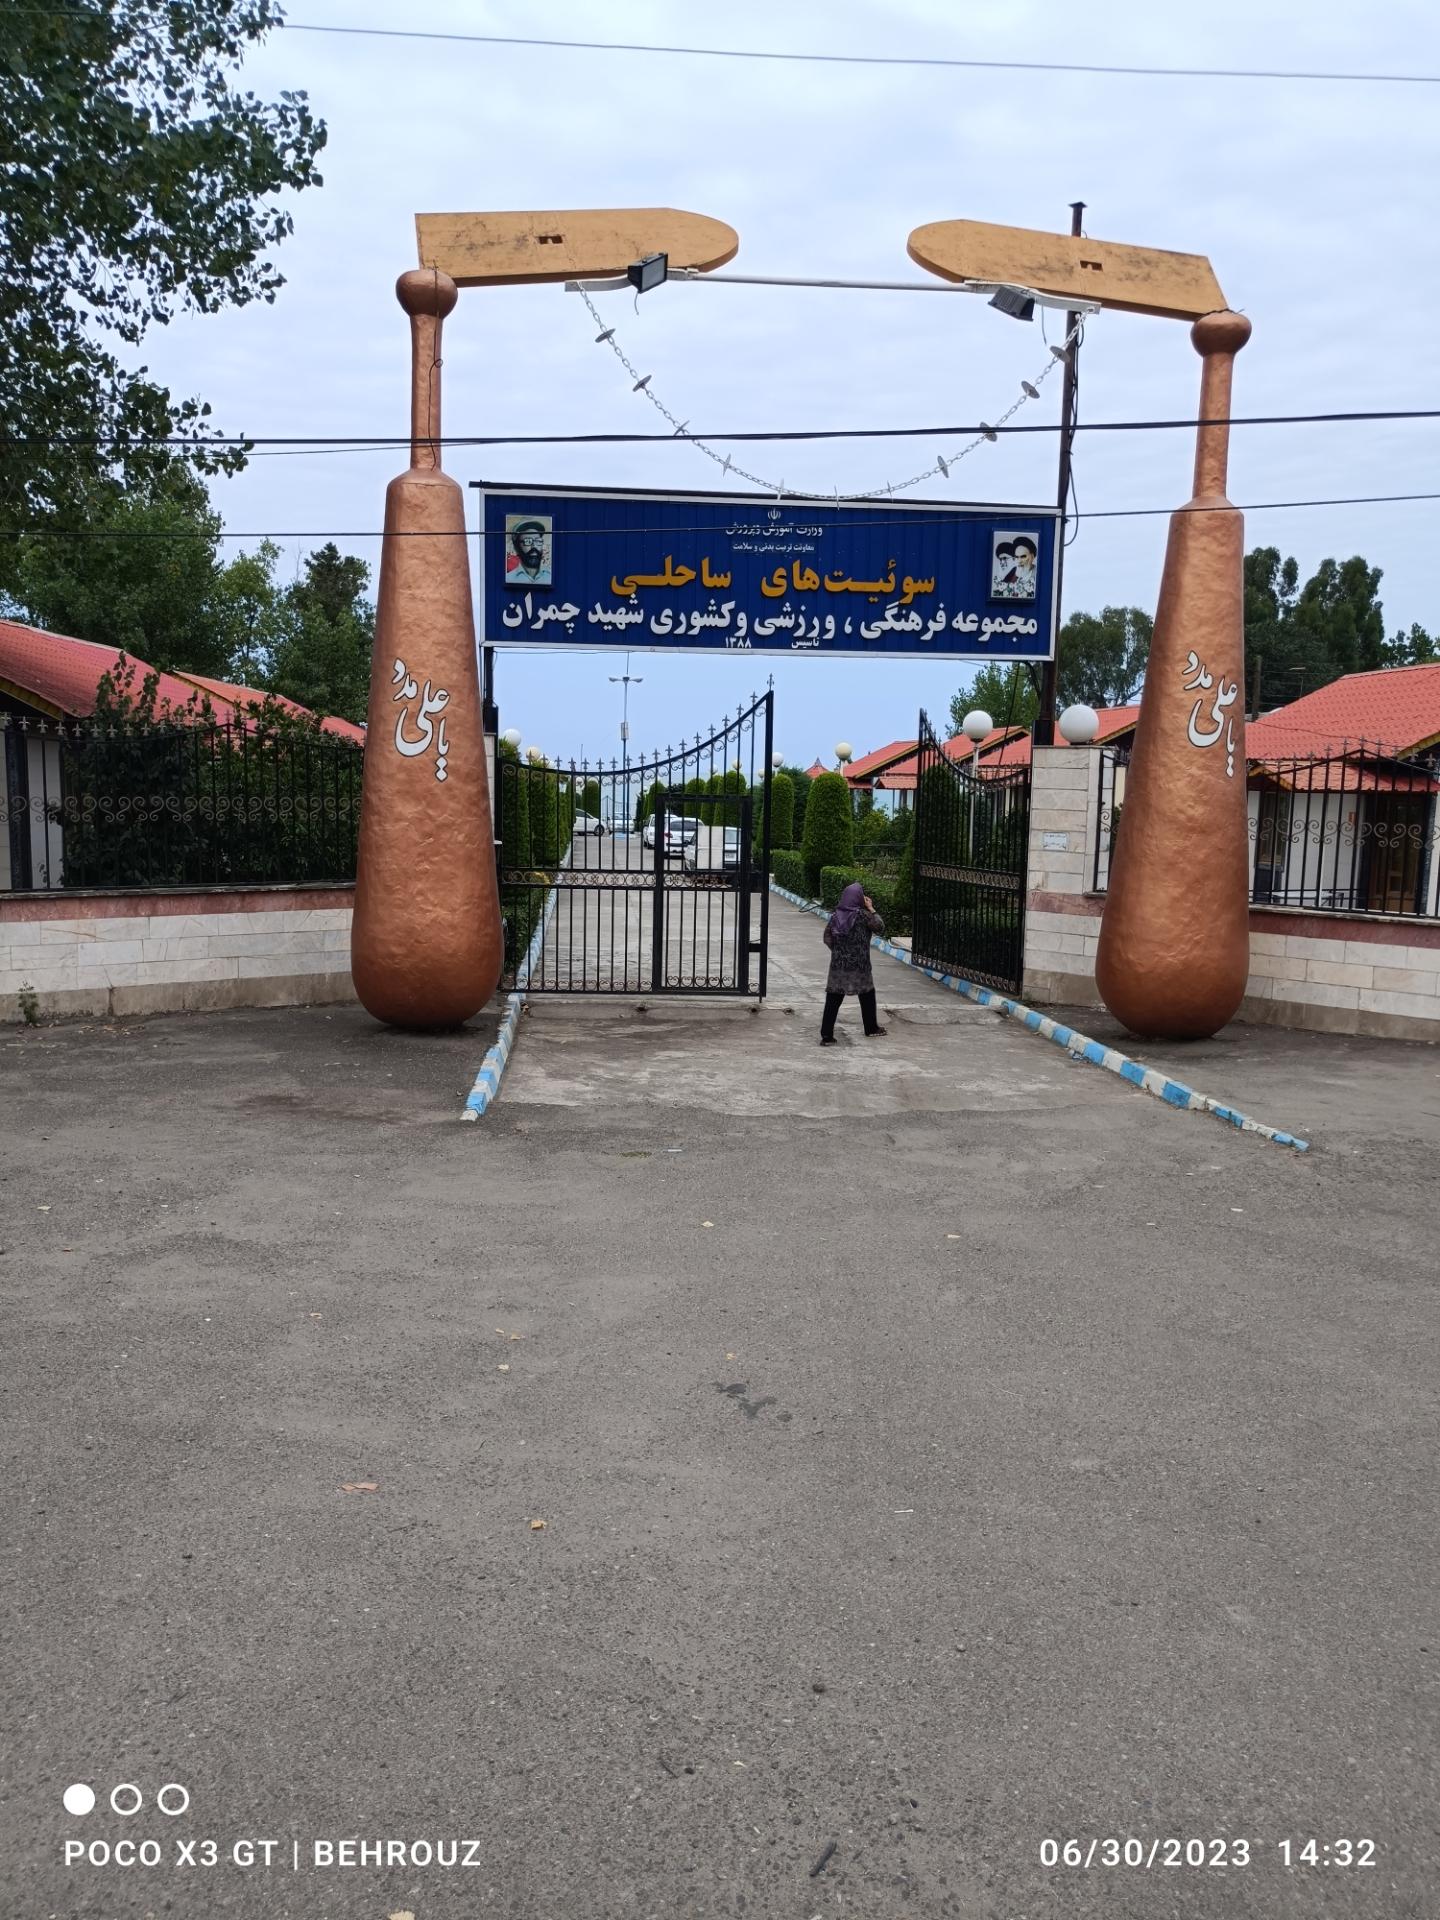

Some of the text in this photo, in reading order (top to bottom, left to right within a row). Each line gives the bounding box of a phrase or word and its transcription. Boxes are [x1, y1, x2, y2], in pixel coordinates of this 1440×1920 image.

[732, 542, 753, 551] سلامت
[759, 543, 774, 552] بدنی
[775, 543, 793, 552] تربیت
[793, 543, 815, 552] معاونت
[611, 554, 732, 596] ساحلی
[502, 591, 581, 634] چمران
[587, 594, 644, 631] شهید
[754, 601, 836, 640] ورزشی
[860, 601, 947, 641] فرهنگی
[951, 610, 1038, 642] مجموعه
[391, 657, 450, 783] یا علی مدد
[1182, 650, 1238, 778] یا علی مدد
